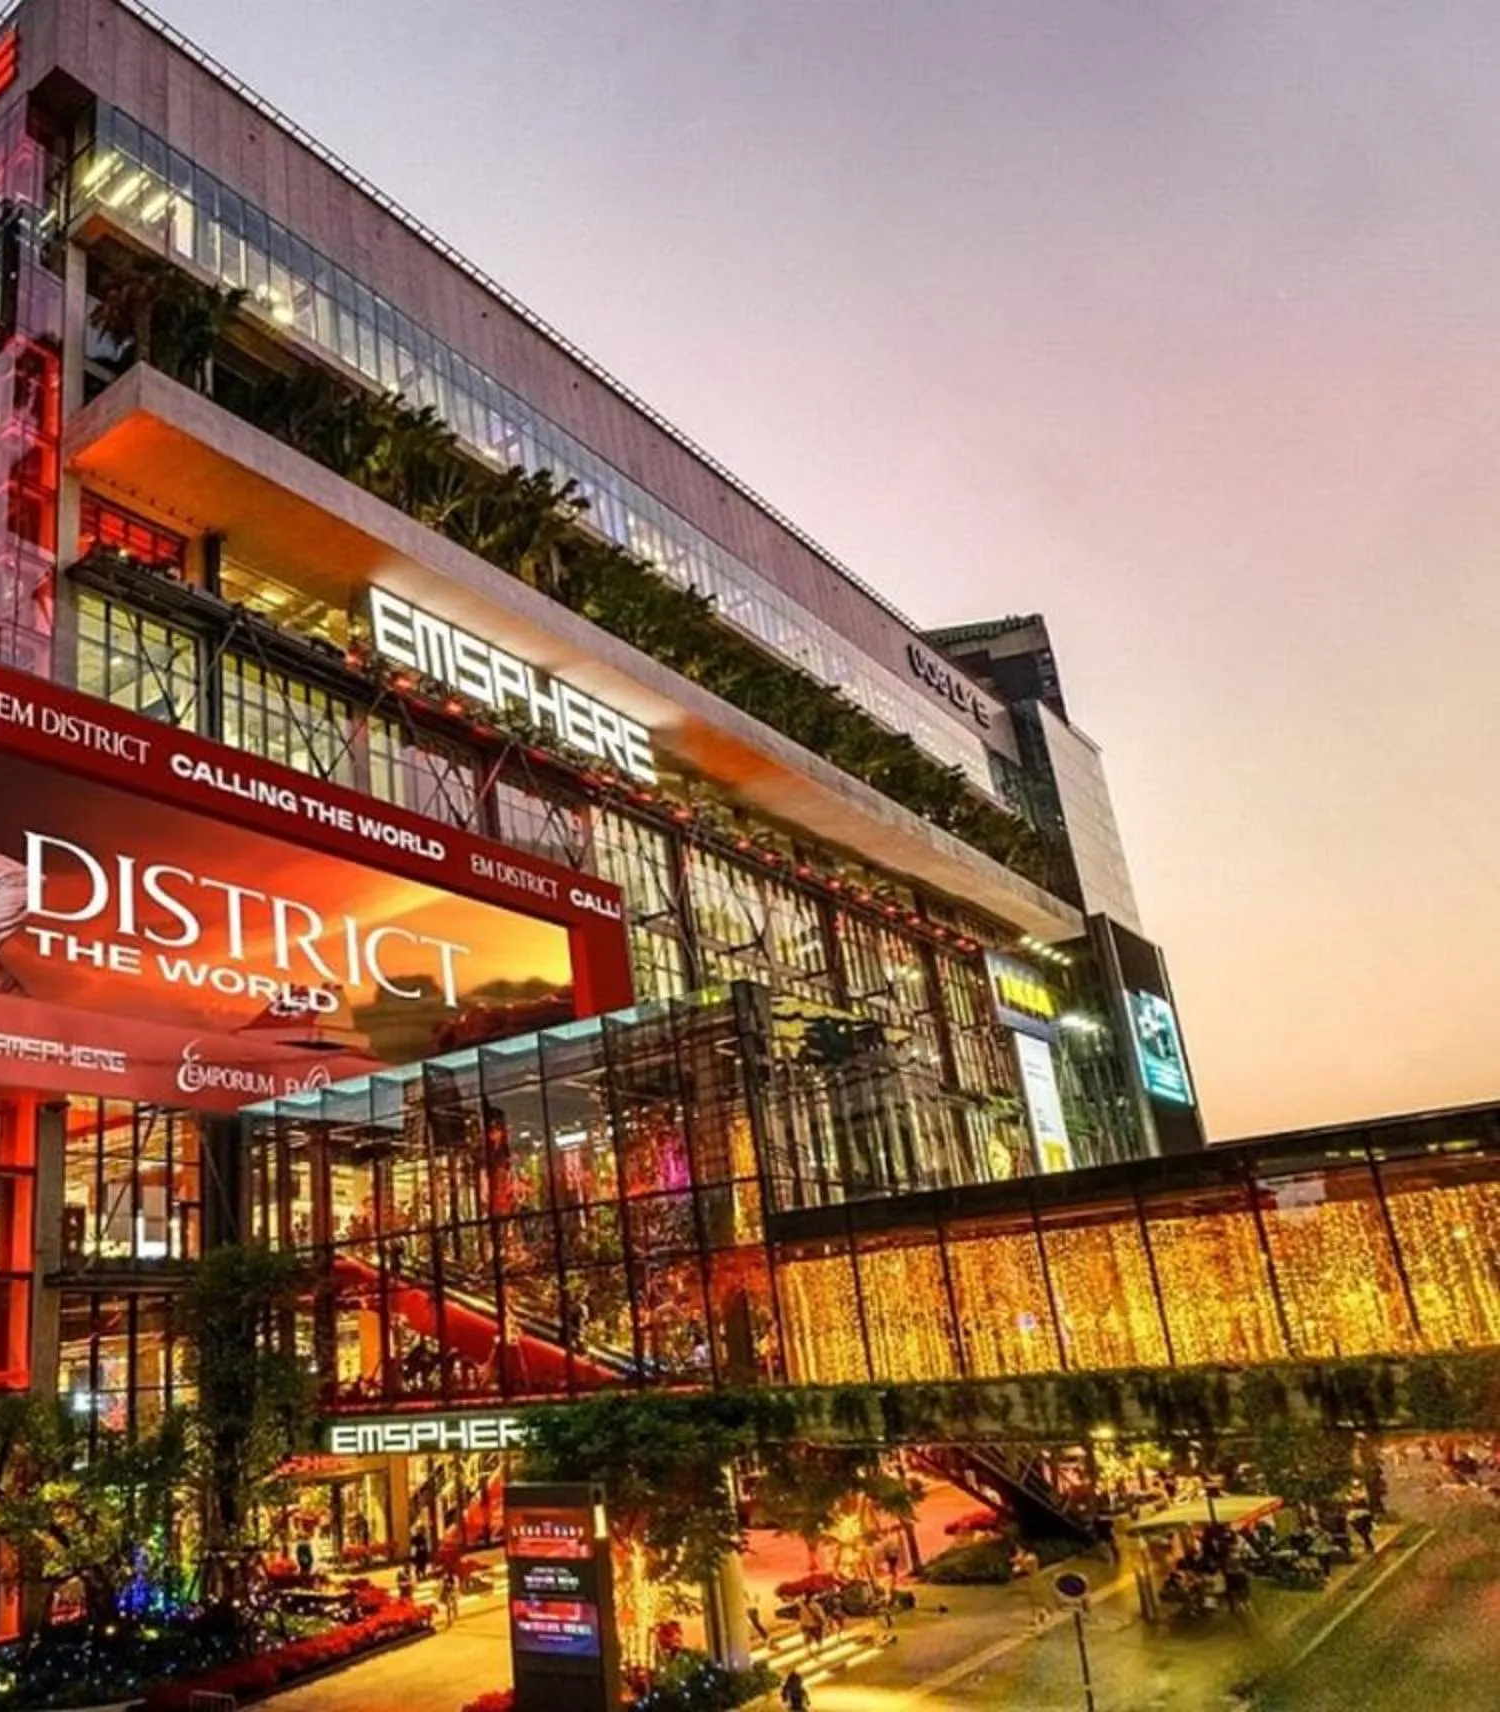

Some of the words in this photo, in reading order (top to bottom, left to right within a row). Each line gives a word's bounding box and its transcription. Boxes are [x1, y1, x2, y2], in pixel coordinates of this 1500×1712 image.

[370, 585, 658, 785] EMSPHERE
[41, 710, 151, 766] DISTRICT
[170, 753, 299, 814] CALLING
[301, 796, 353, 831] THE
[358, 813, 445, 862] WORLD
[496, 862, 560, 901] DISTRICT
[23, 830, 470, 1010] DISTRICT
[25, 925, 143, 975] THE
[156, 953, 339, 1014] WORLD
[331, 1417, 530, 1454] EMSPHER
